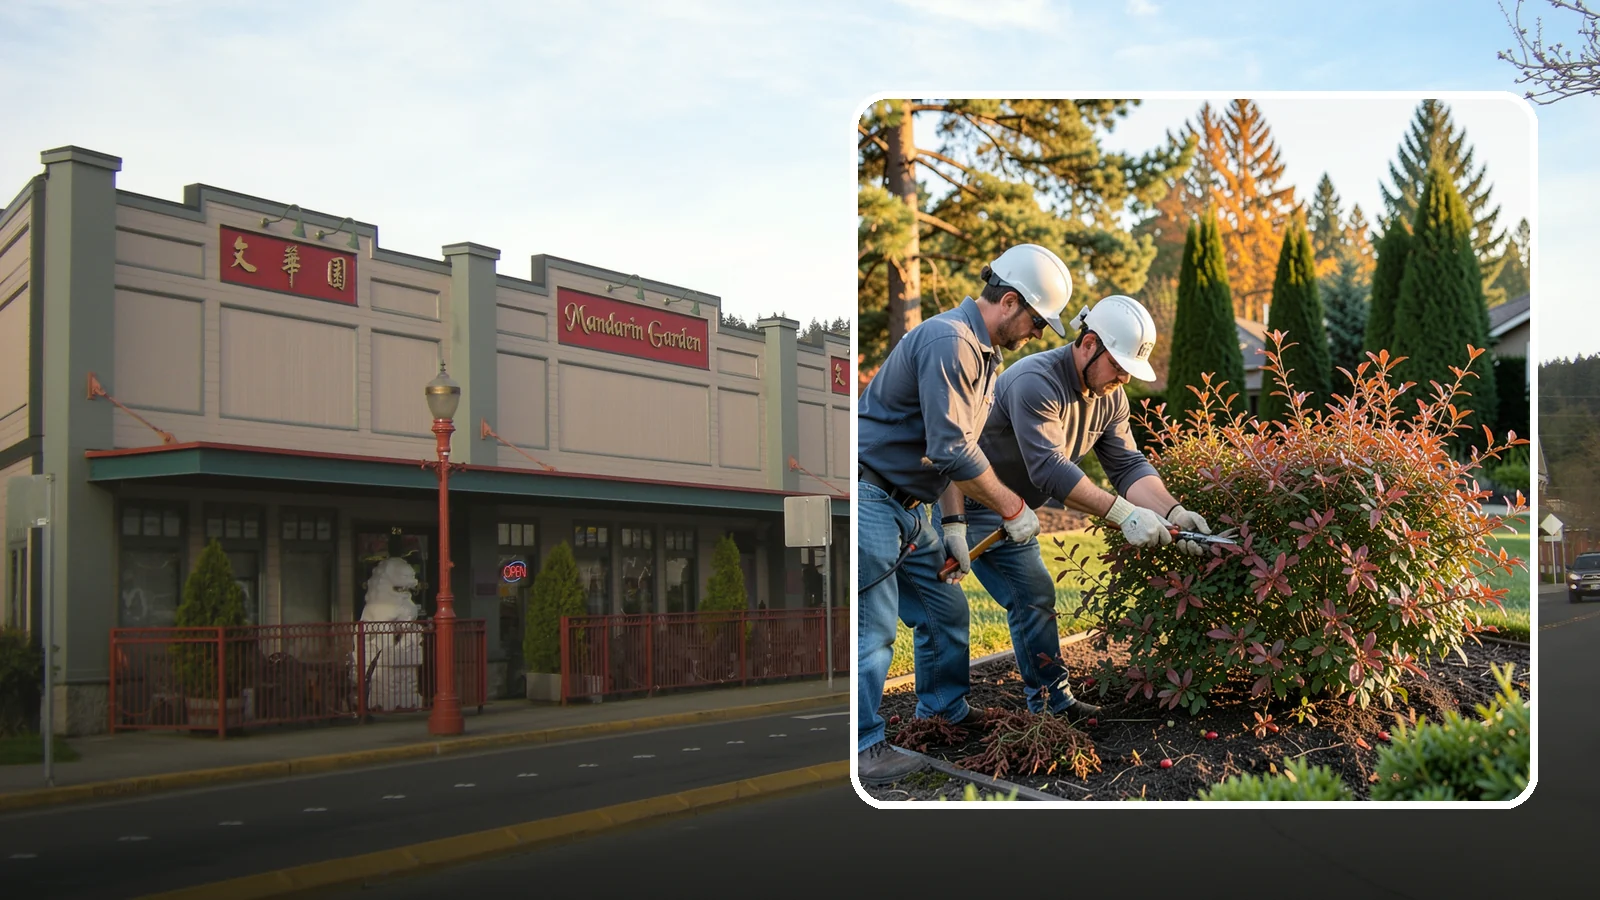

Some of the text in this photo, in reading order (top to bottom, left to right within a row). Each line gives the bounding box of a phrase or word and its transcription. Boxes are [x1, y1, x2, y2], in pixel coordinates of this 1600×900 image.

[230, 235, 346, 291] 文華園
[564, 302, 701, 352] Mandarin Garden
[834, 363, 846, 386] 文
[503, 565, 527, 578] OPEN
